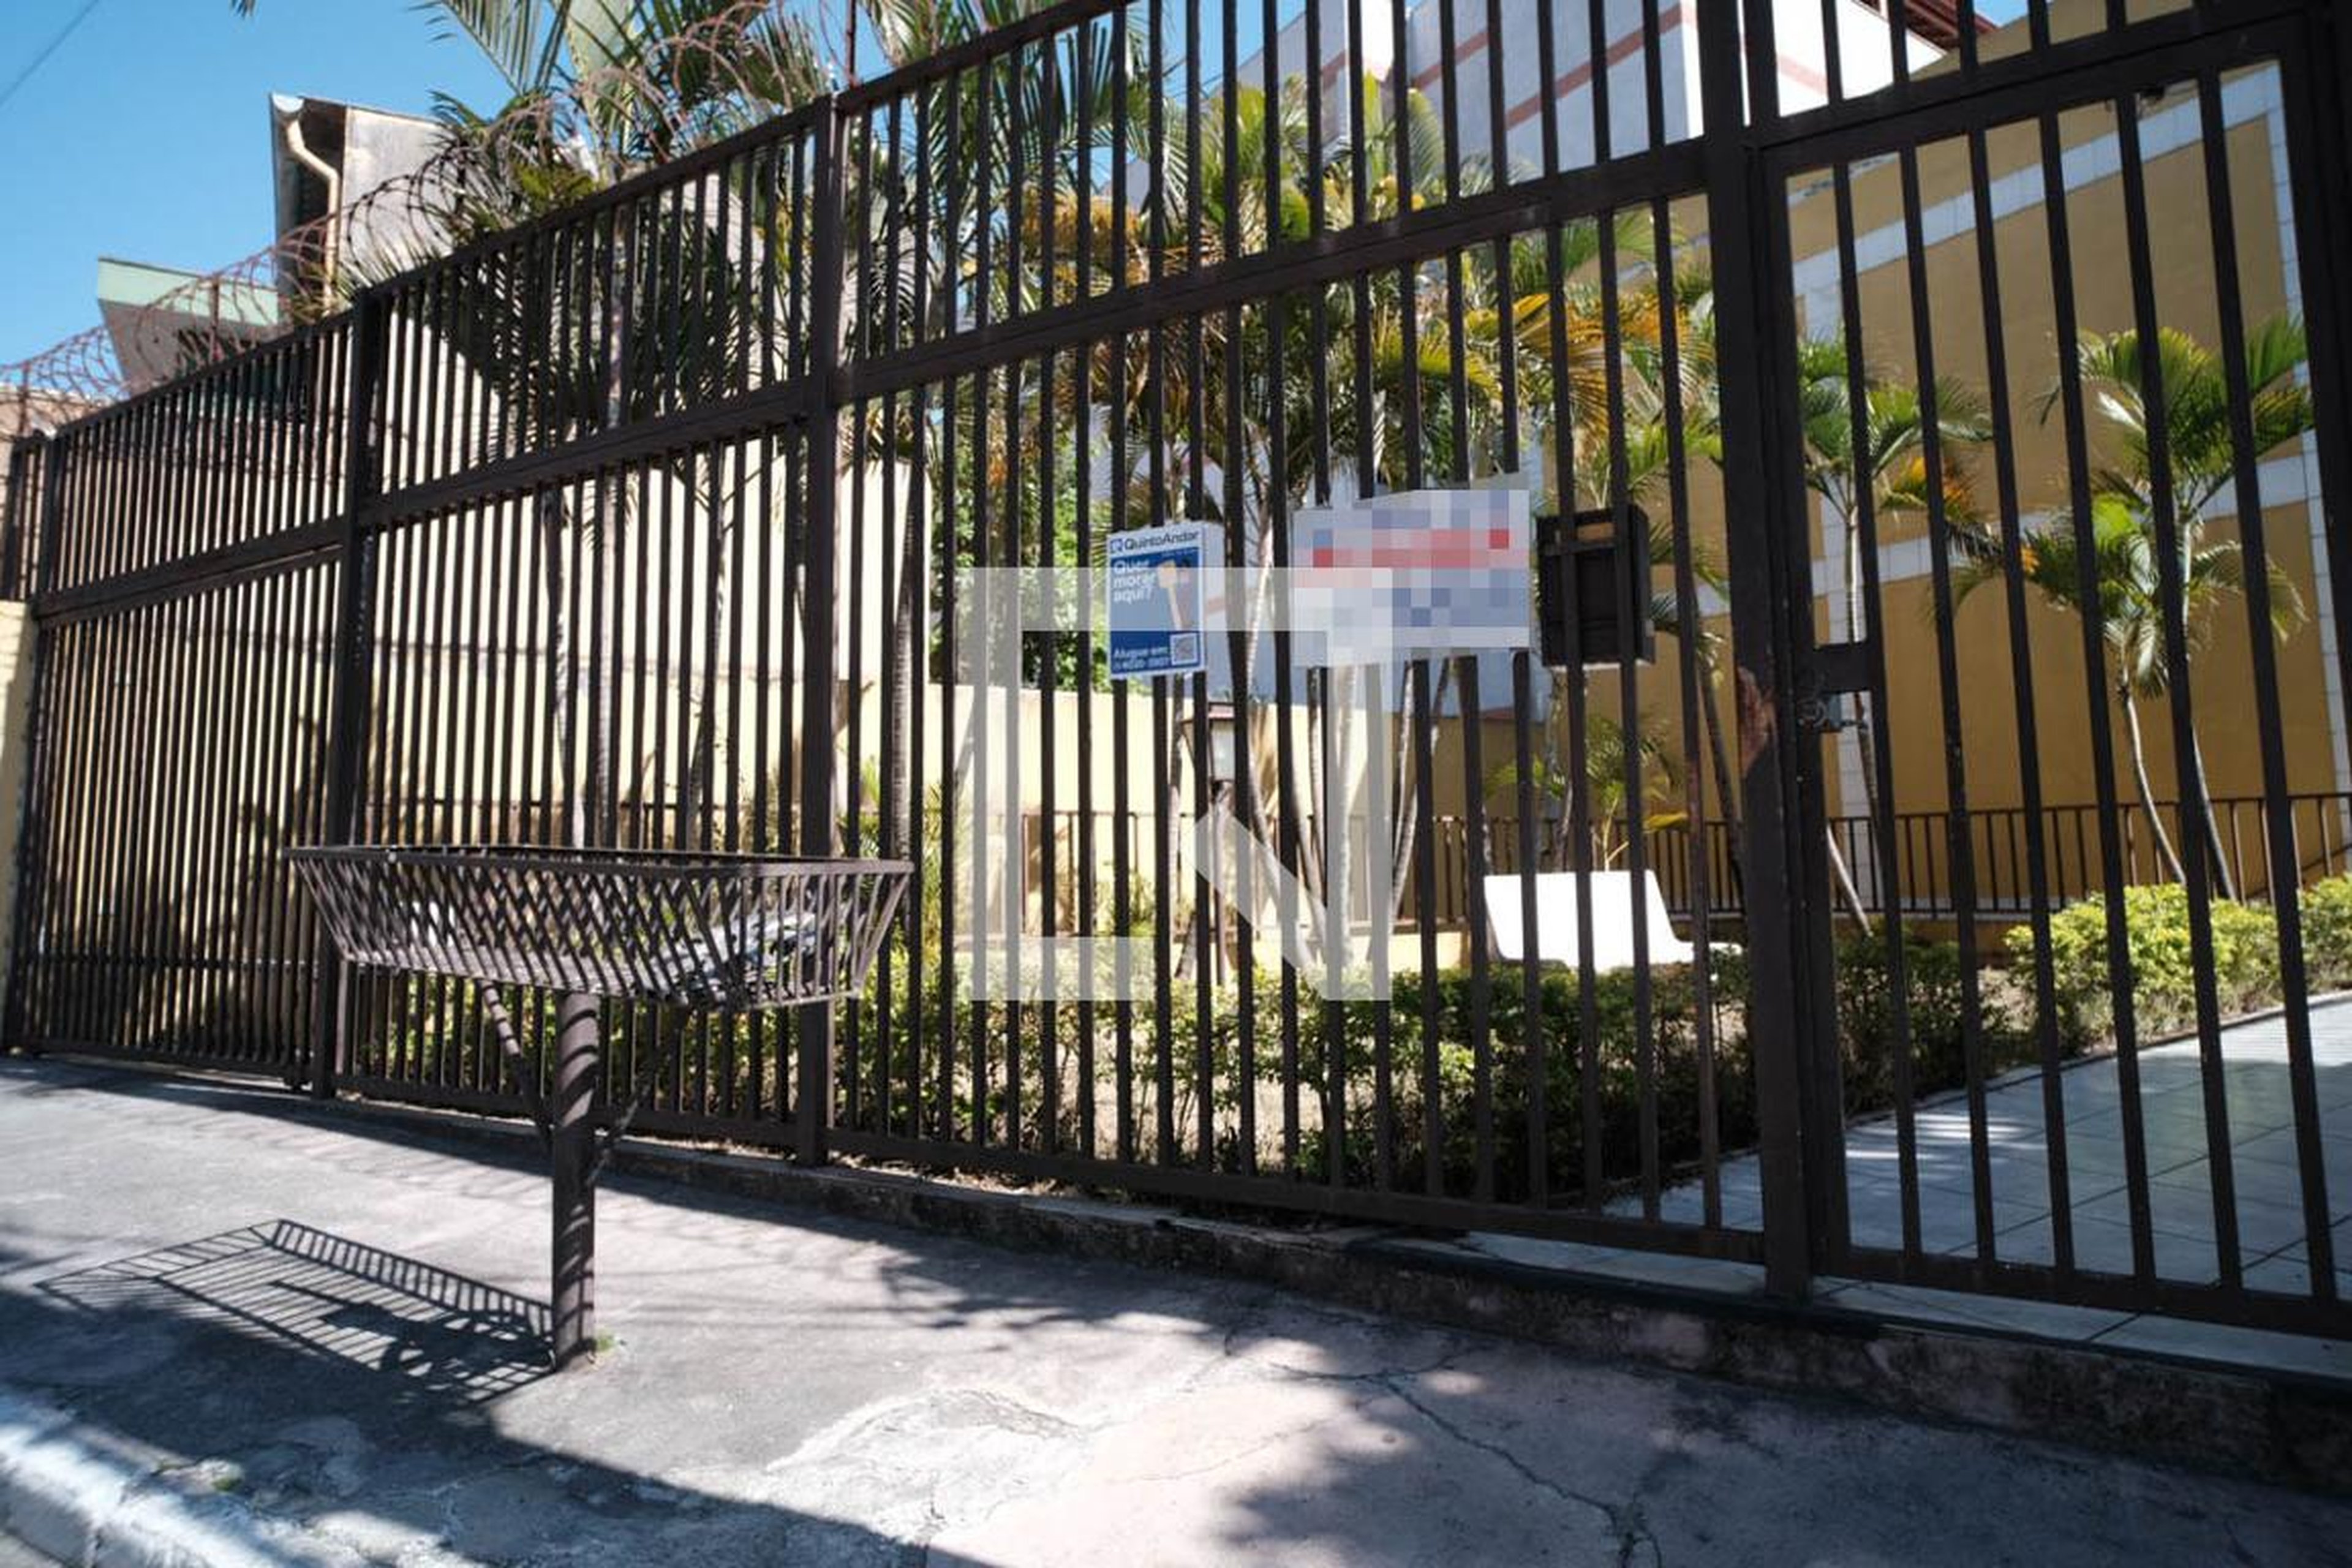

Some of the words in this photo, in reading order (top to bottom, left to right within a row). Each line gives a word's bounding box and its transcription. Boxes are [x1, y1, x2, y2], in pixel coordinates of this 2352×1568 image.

[1125, 532, 1199, 550] QuintoAndar
[1114, 560, 1150, 575] Quer
[1114, 573, 1156, 588] morar
[1113, 587, 1152, 604] aqui?
